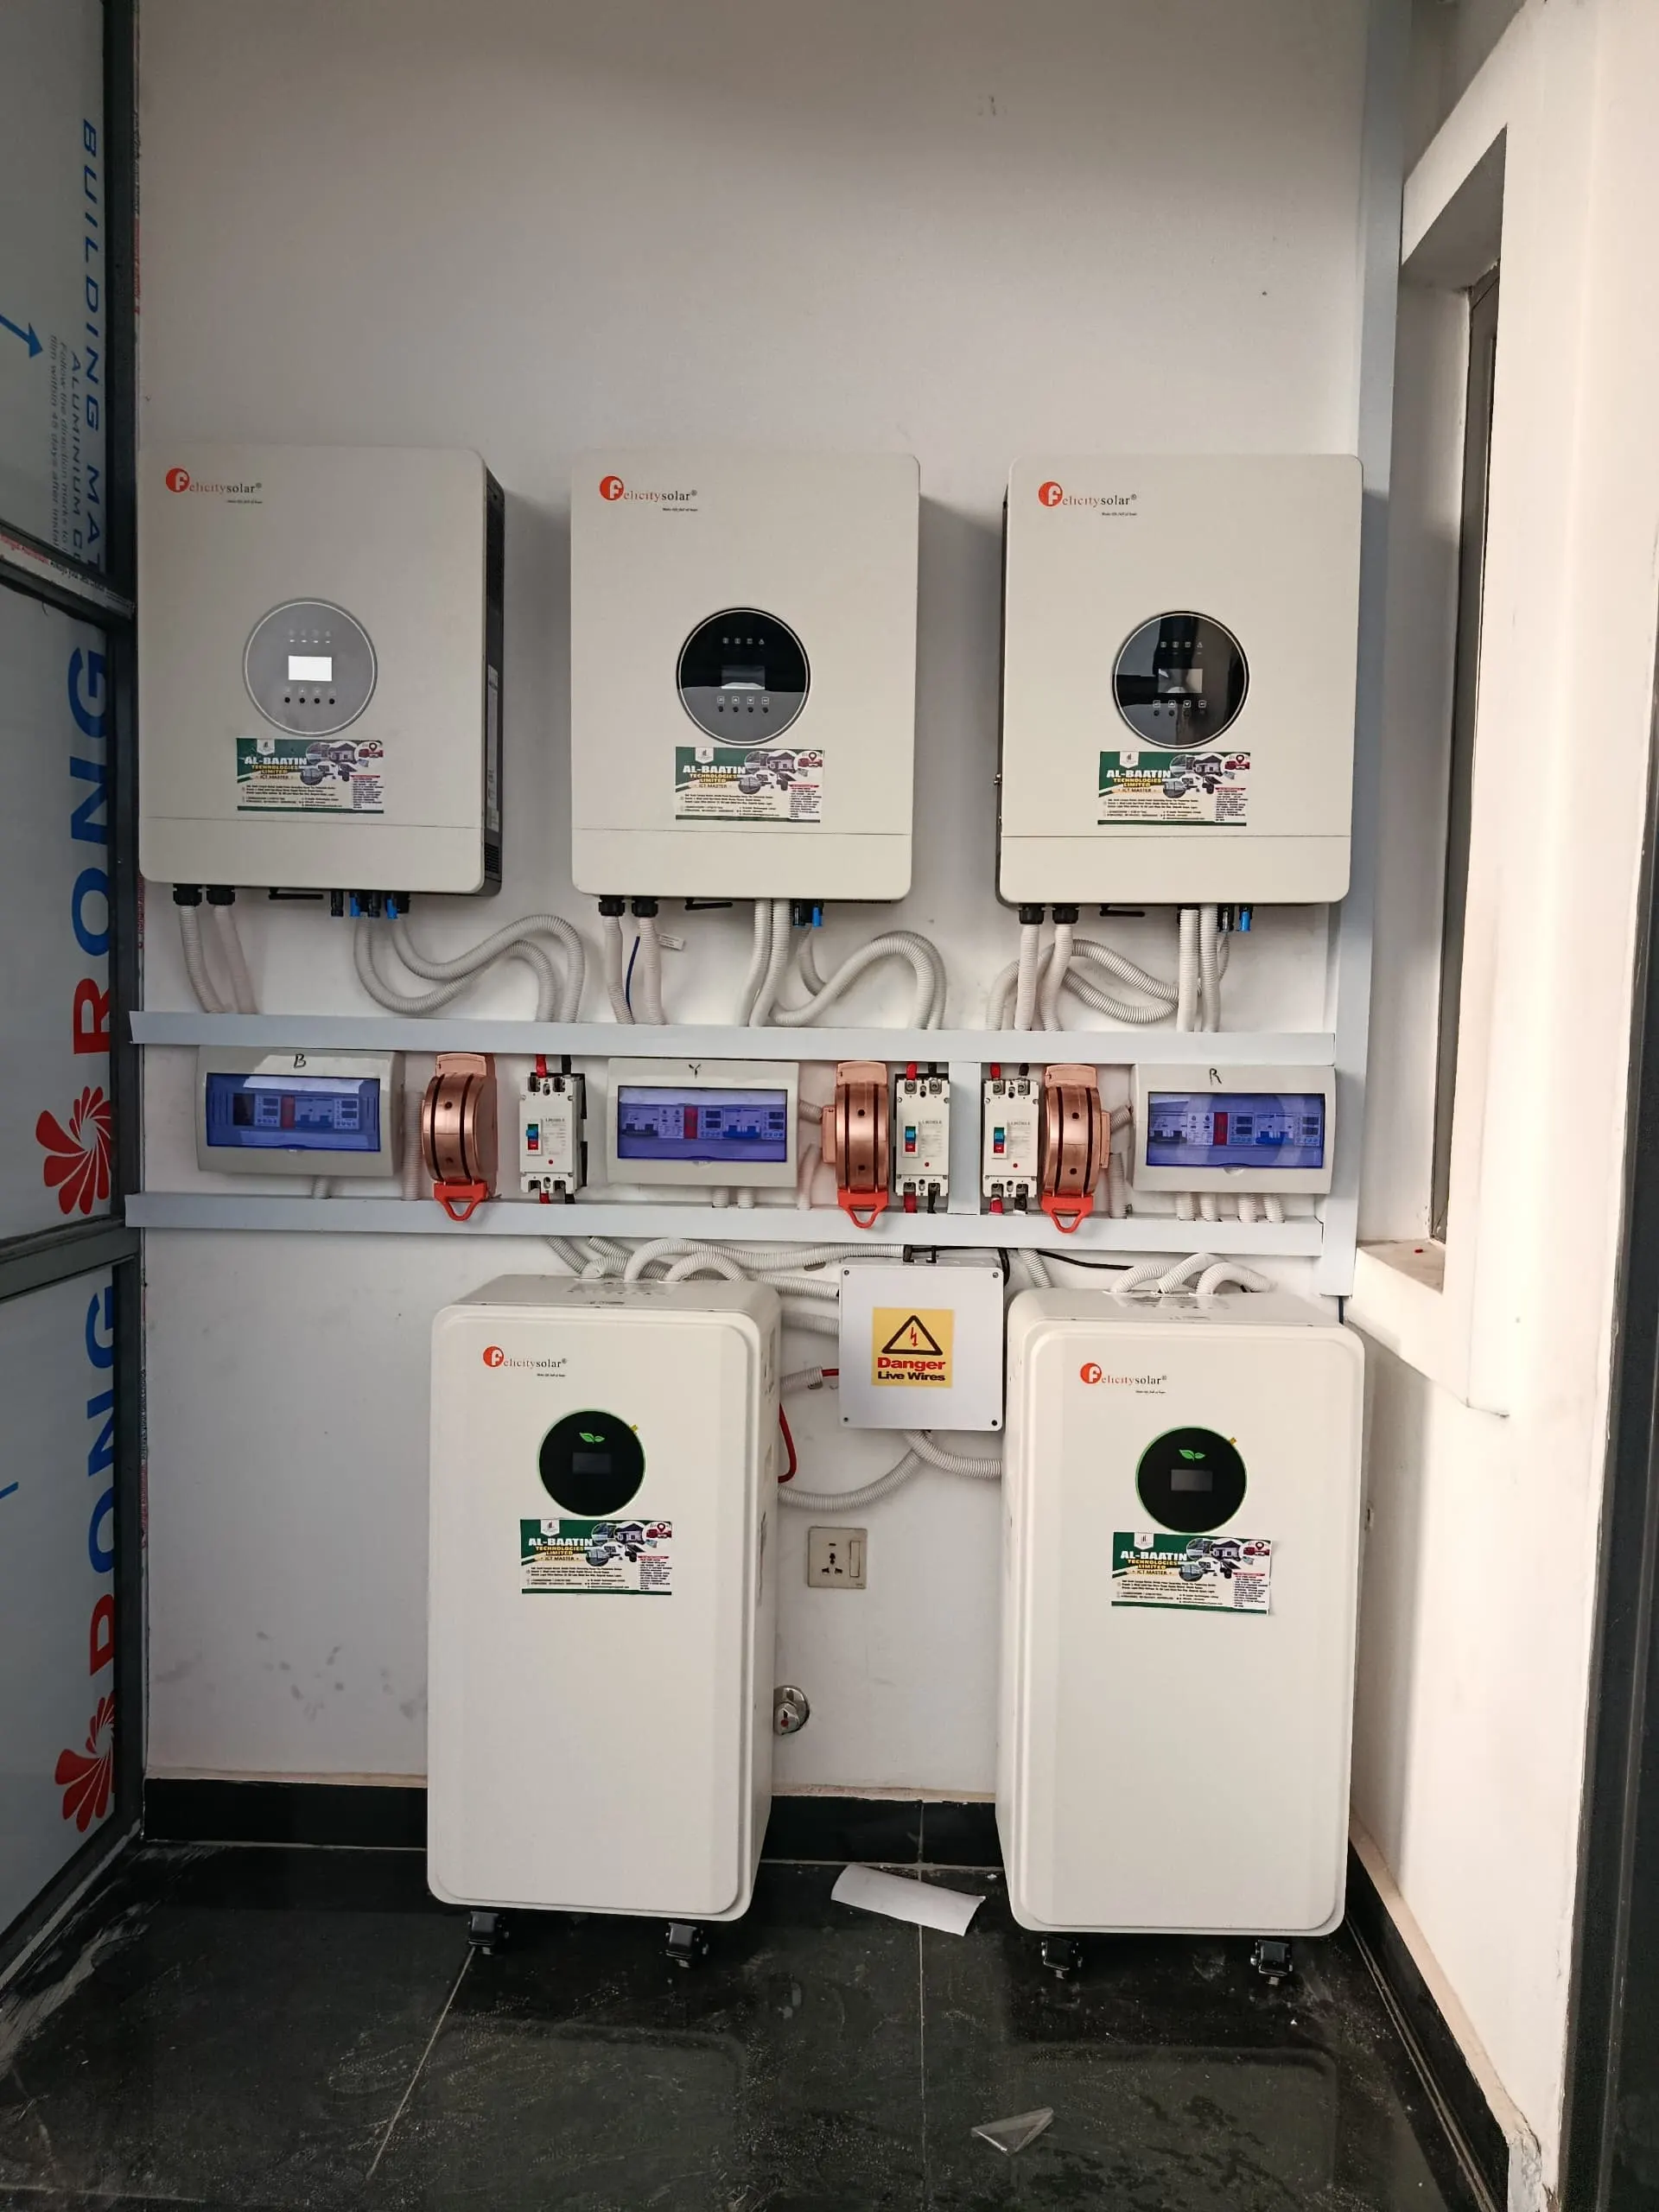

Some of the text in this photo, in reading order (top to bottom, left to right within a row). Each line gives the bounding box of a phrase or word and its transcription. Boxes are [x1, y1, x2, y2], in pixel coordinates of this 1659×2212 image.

[83, 118, 99, 432] BUILDING
[51, 365, 60, 407] within
[71, 352, 83, 516] ALUMINIUM
[245, 756, 308, 766] AL-BAATIN
[683, 765, 747, 774] AL-BAATIN
[1106, 769, 1172, 779] AL-BAATIN
[294, 1053, 306, 1068] B
[689, 1064, 701, 1078] Y
[1210, 1068, 1222, 1084] R
[877, 1357, 946, 1371] Danger
[877, 1371, 946, 1382] Live Wires
[528, 1538, 593, 1547] AL-BAATIN
[1120, 1550, 1188, 1560] AL-BAATIN
